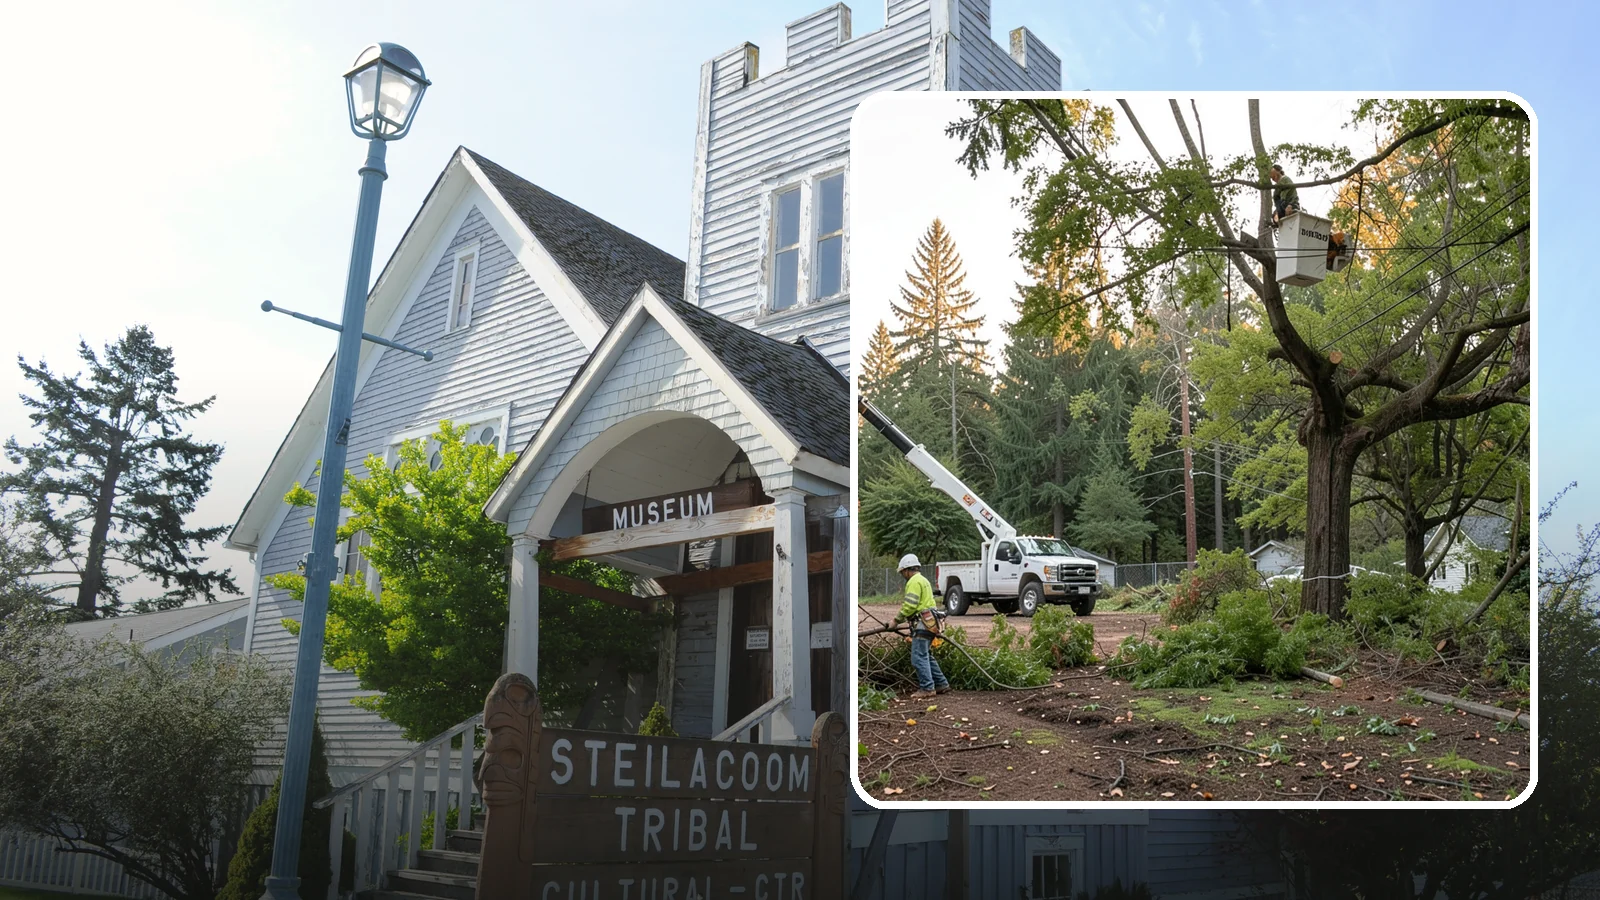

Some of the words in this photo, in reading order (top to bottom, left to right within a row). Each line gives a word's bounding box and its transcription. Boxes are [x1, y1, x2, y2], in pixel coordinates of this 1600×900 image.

[613, 491, 713, 530] MUSEUM
[550, 738, 809, 793] STEILACOOM
[614, 806, 758, 852] TRIBAL
